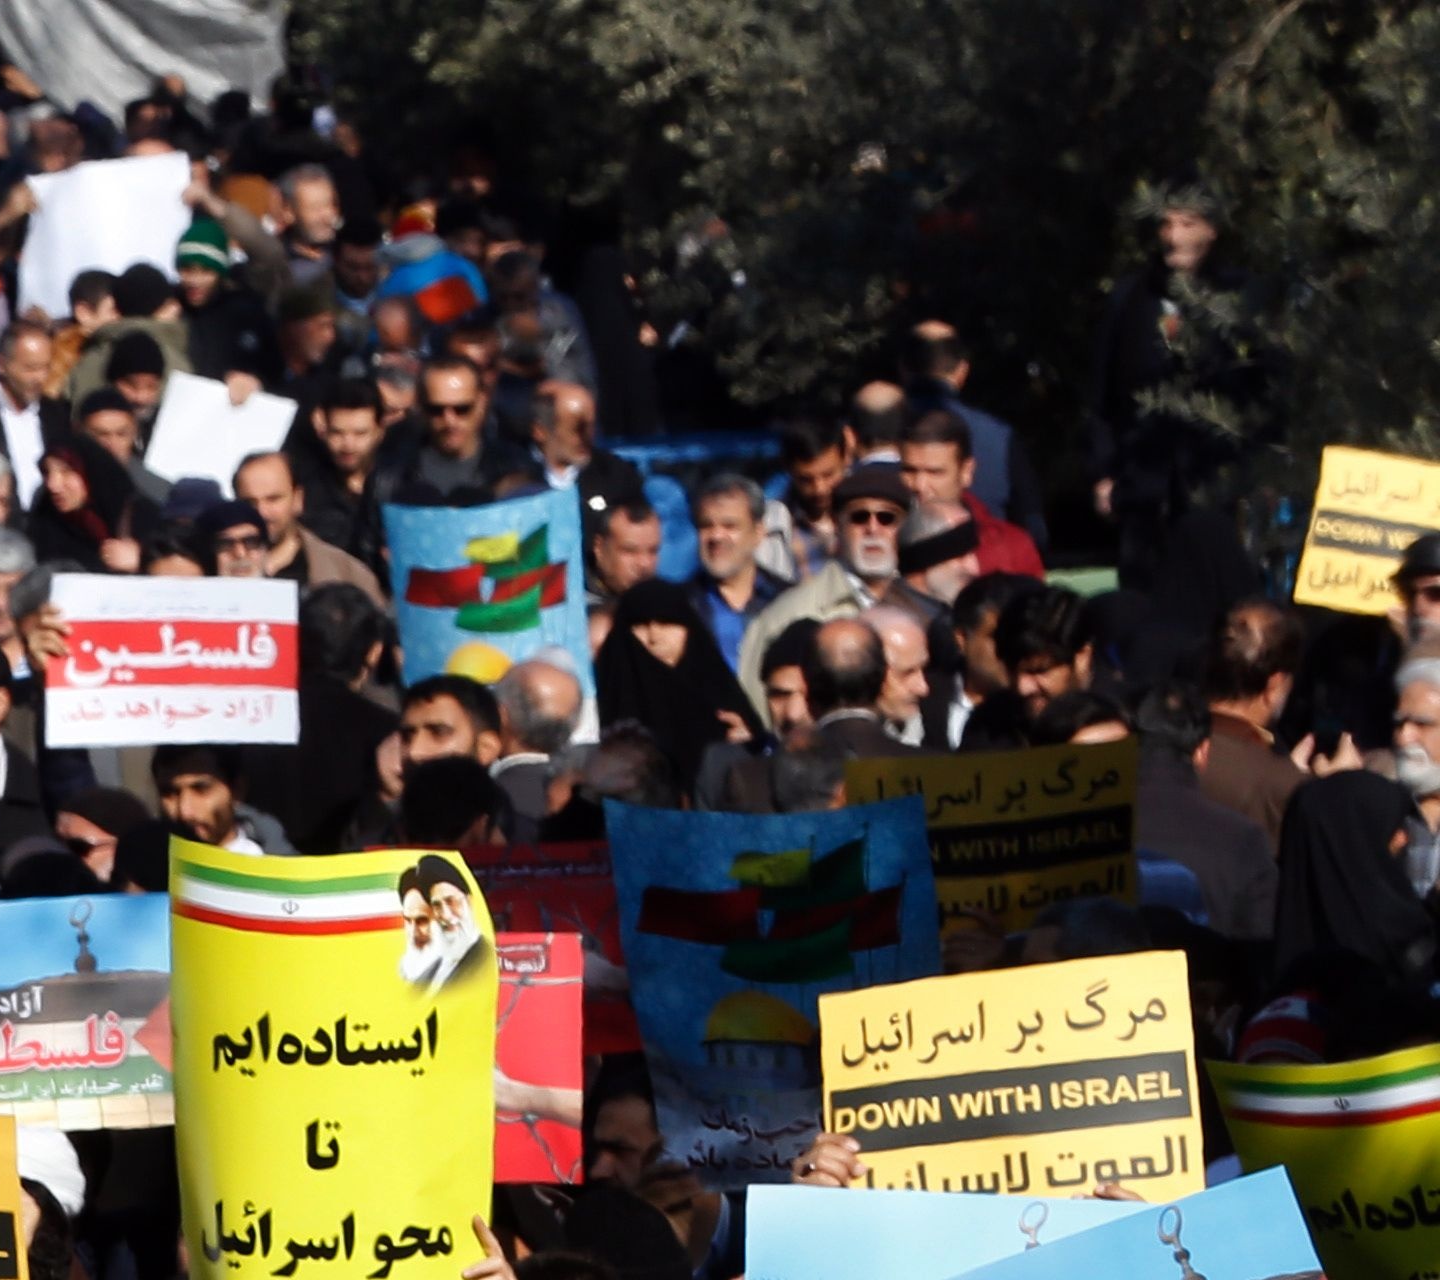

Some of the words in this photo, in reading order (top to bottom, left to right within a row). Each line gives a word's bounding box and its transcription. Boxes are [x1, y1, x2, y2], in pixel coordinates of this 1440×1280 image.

[65, 624, 277, 685] فلسطین
[224, 694, 275, 721] آزاد
[1026, 818, 1124, 854] ISRAEL
[833, 1096, 940, 1132] DOWN
[948, 1088, 1043, 1122] WITH
[1050, 1072, 1182, 1112] ISRAEL
[304, 1117, 340, 1169] تا
[202, 1203, 356, 1278] اسرائیل
[367, 1220, 454, 1280] محو
